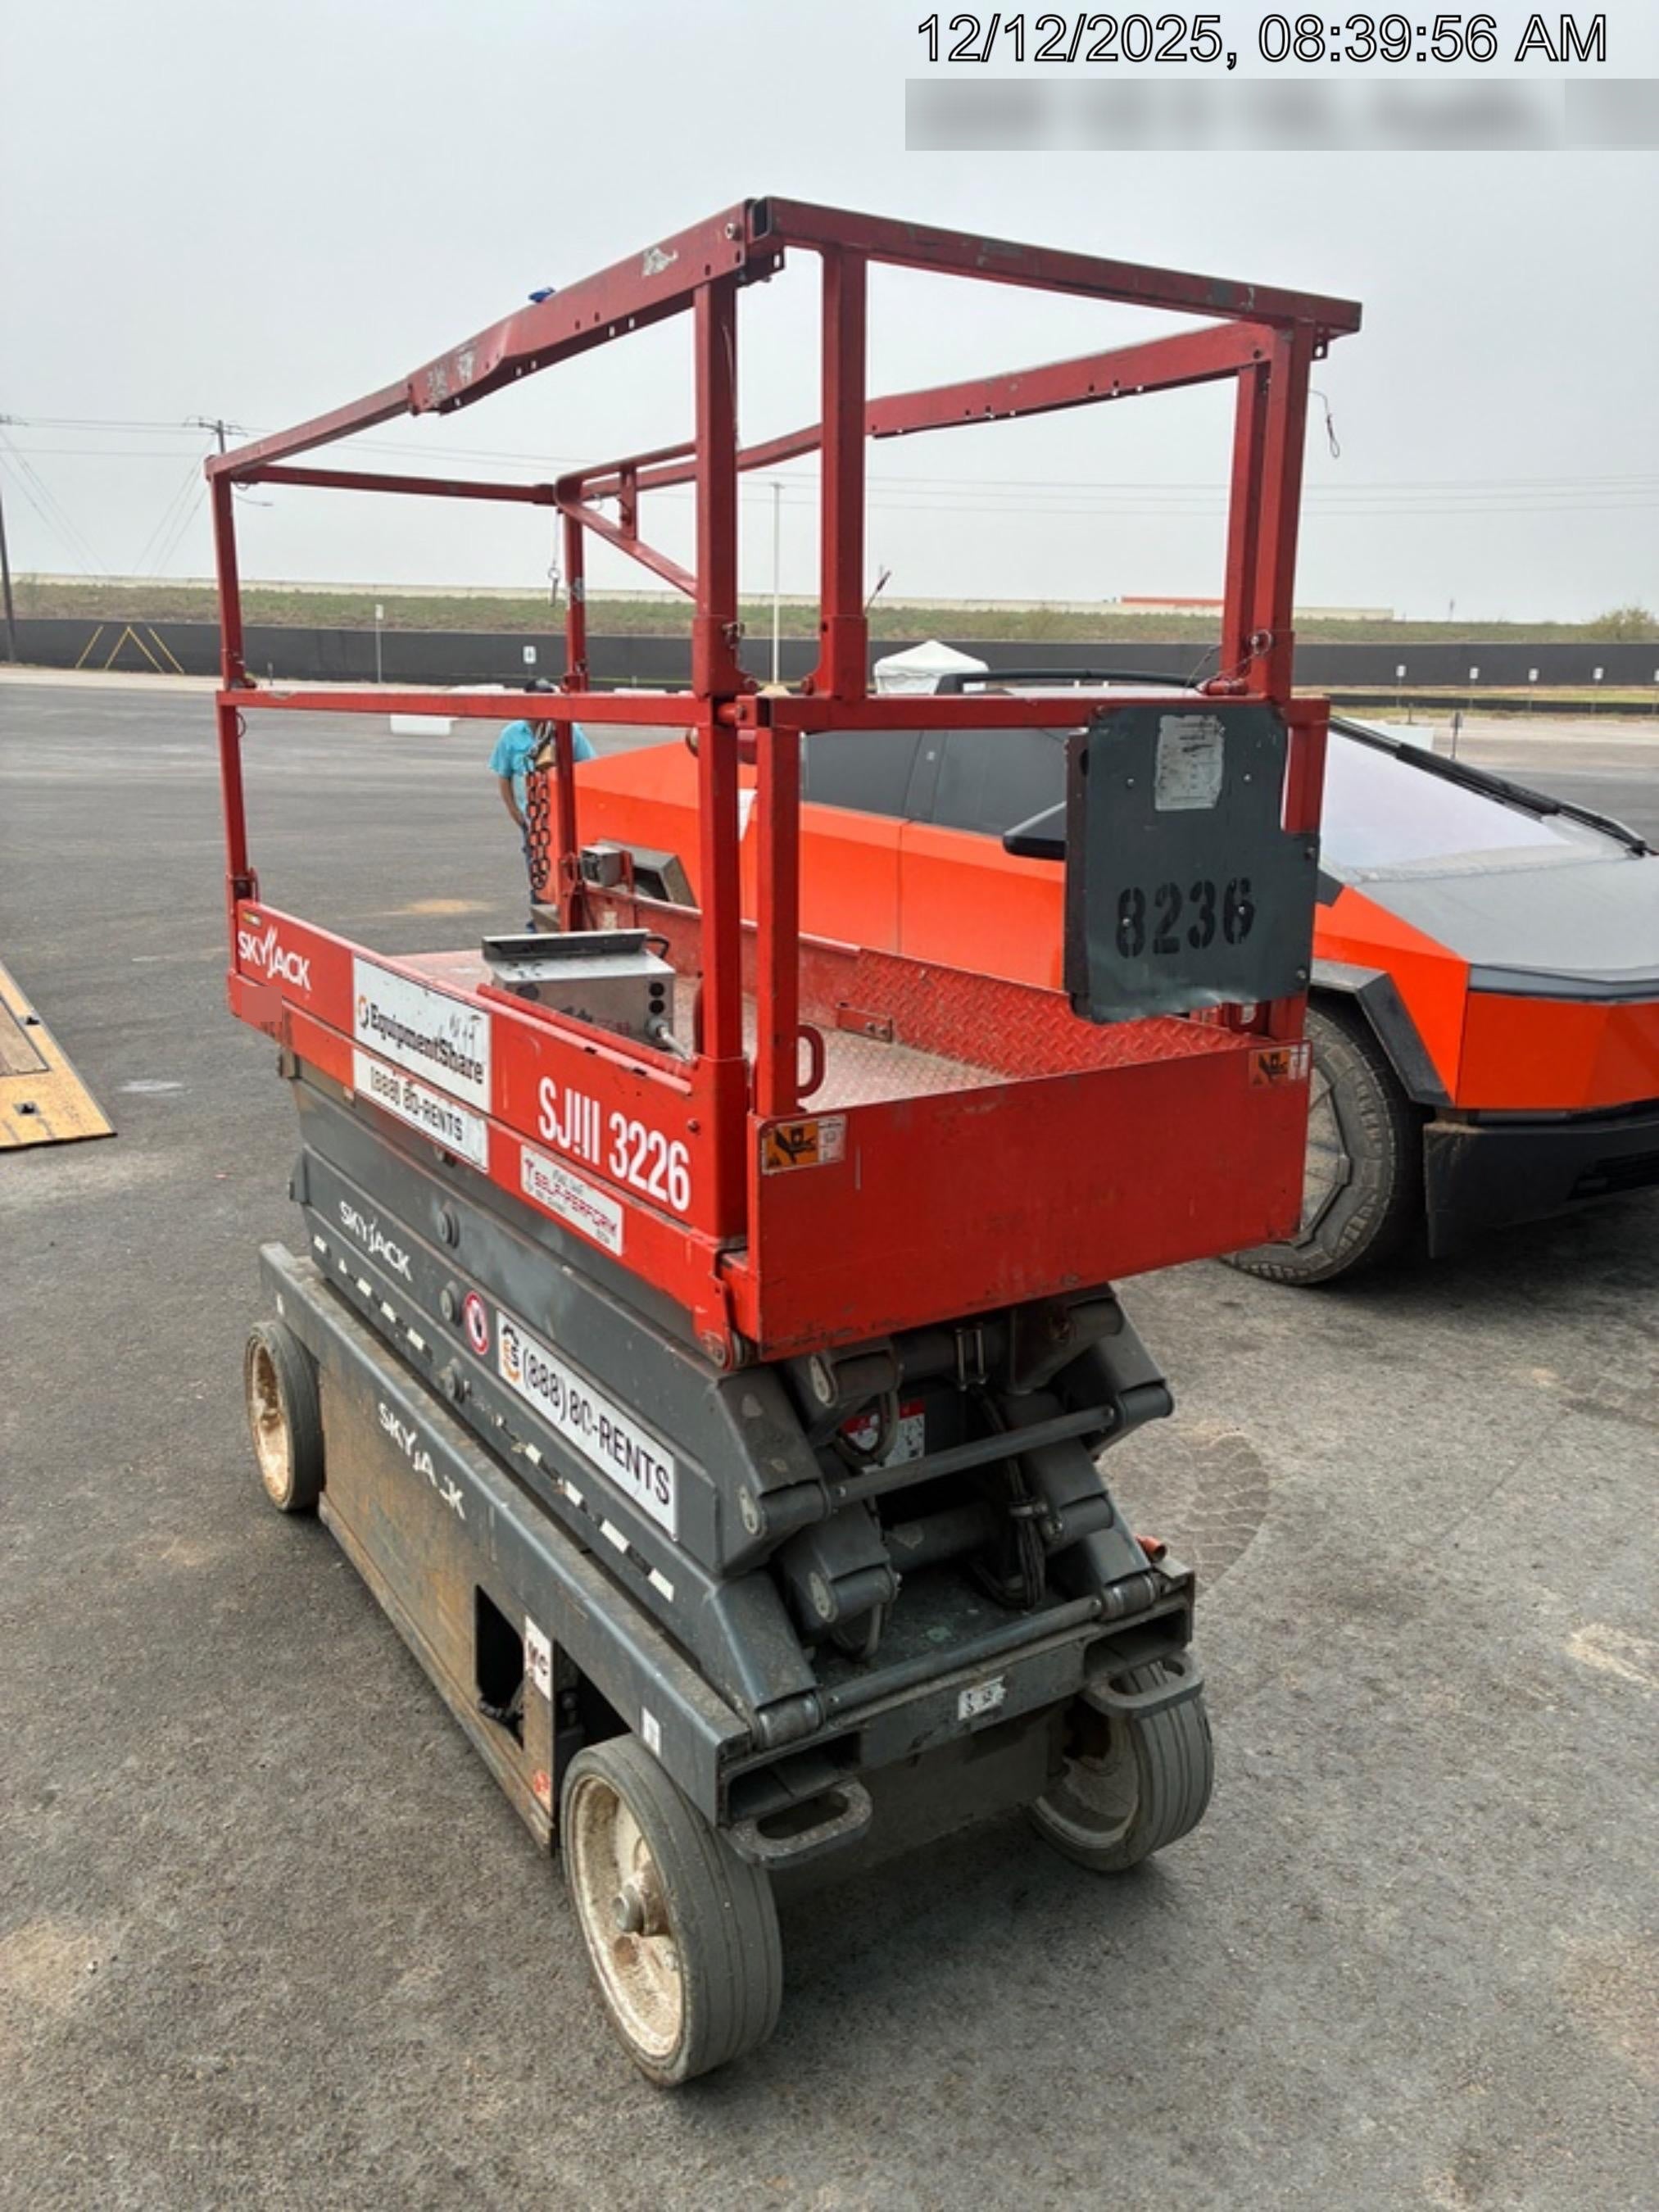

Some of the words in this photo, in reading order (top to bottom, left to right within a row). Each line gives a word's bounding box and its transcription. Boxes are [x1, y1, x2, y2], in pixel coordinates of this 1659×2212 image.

[238, 924, 312, 991] SKYJACK
[1116, 877, 1254, 959] 8236
[370, 1002, 483, 1086] EquipmentShare
[609, 1112, 690, 1212] 3226
